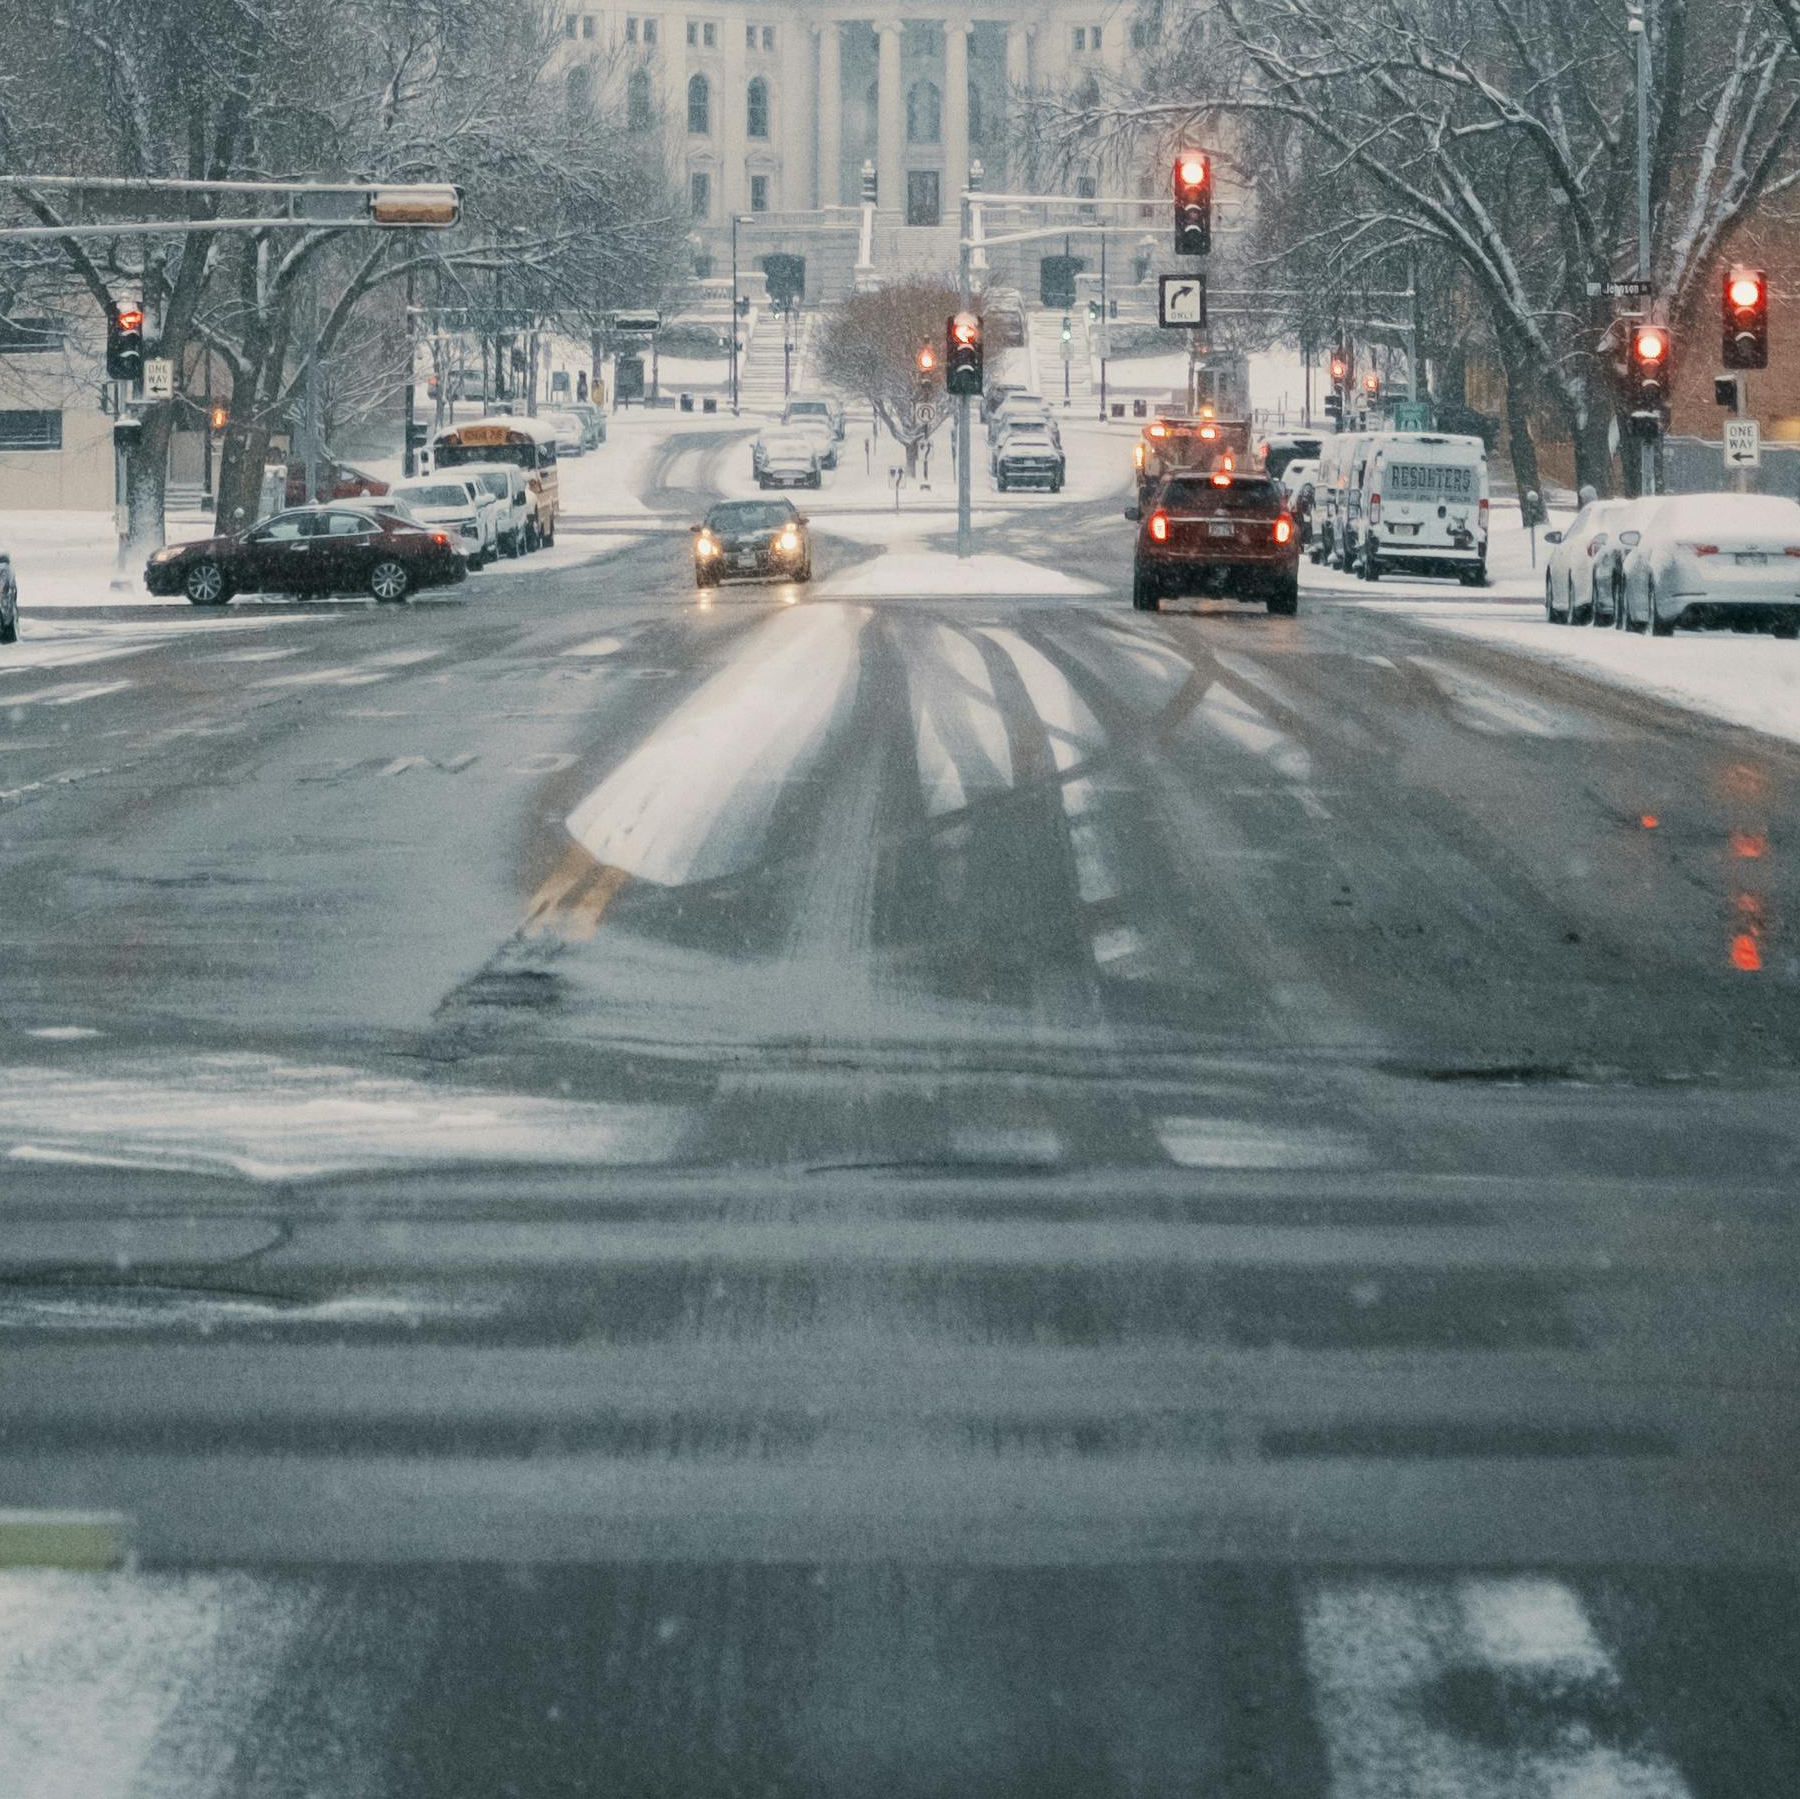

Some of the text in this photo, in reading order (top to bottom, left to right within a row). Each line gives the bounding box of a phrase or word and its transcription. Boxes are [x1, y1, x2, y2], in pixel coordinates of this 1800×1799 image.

[148, 364, 169, 375] ONE
[147, 375, 169, 384] WAY
[1729, 426, 1754, 437] ONE
[1728, 439, 1754, 449] WAY
